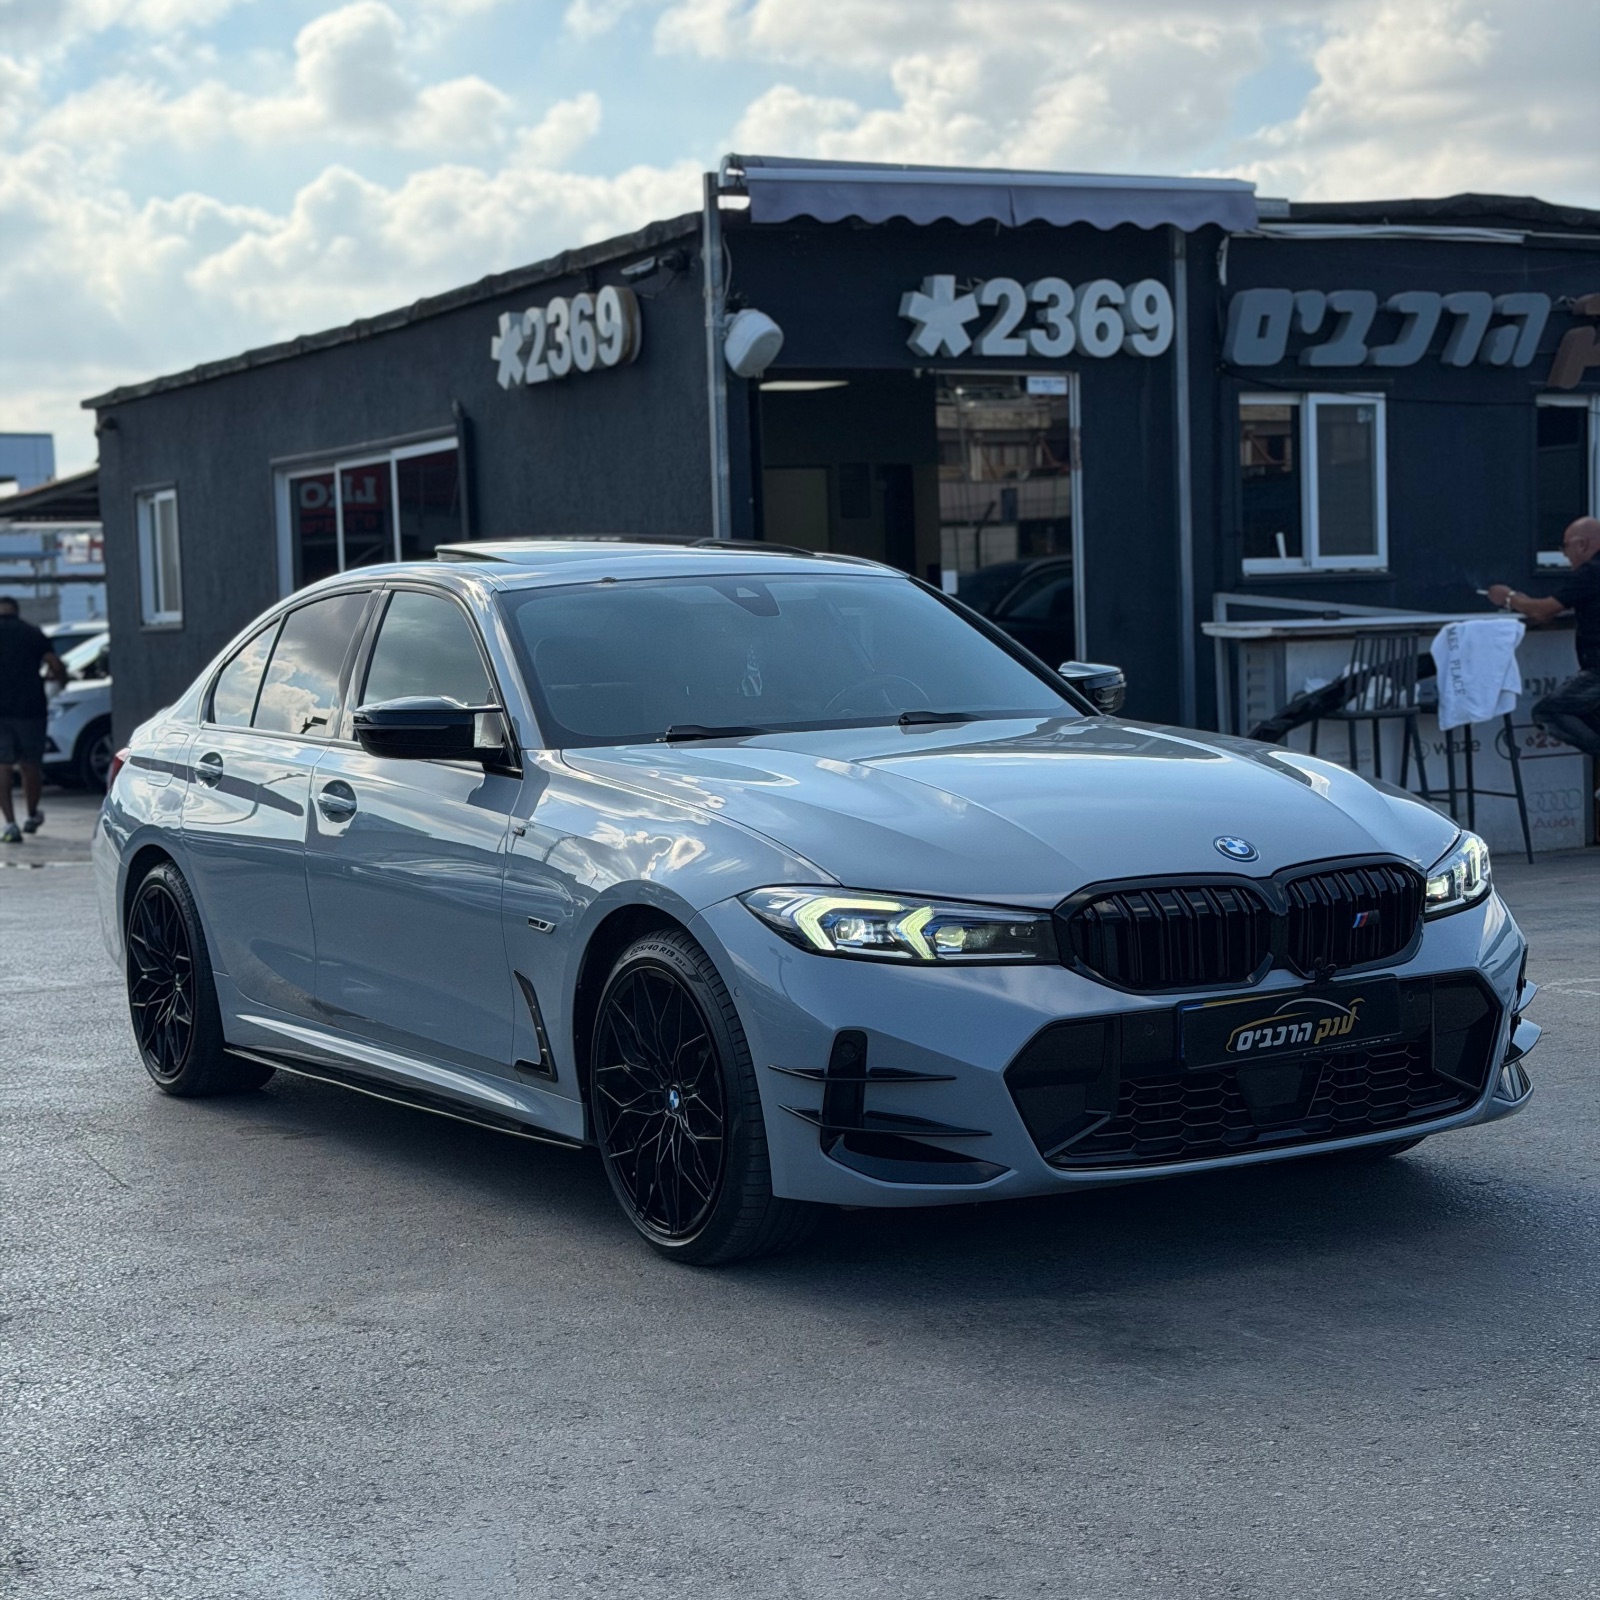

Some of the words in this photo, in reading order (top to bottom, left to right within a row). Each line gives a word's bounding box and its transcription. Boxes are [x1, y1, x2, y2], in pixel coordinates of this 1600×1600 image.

[1224, 288, 1551, 368] הרכבים
[1236, 1021, 1313, 1052] הרכבים
[1313, 1006, 1357, 1045] ענק
